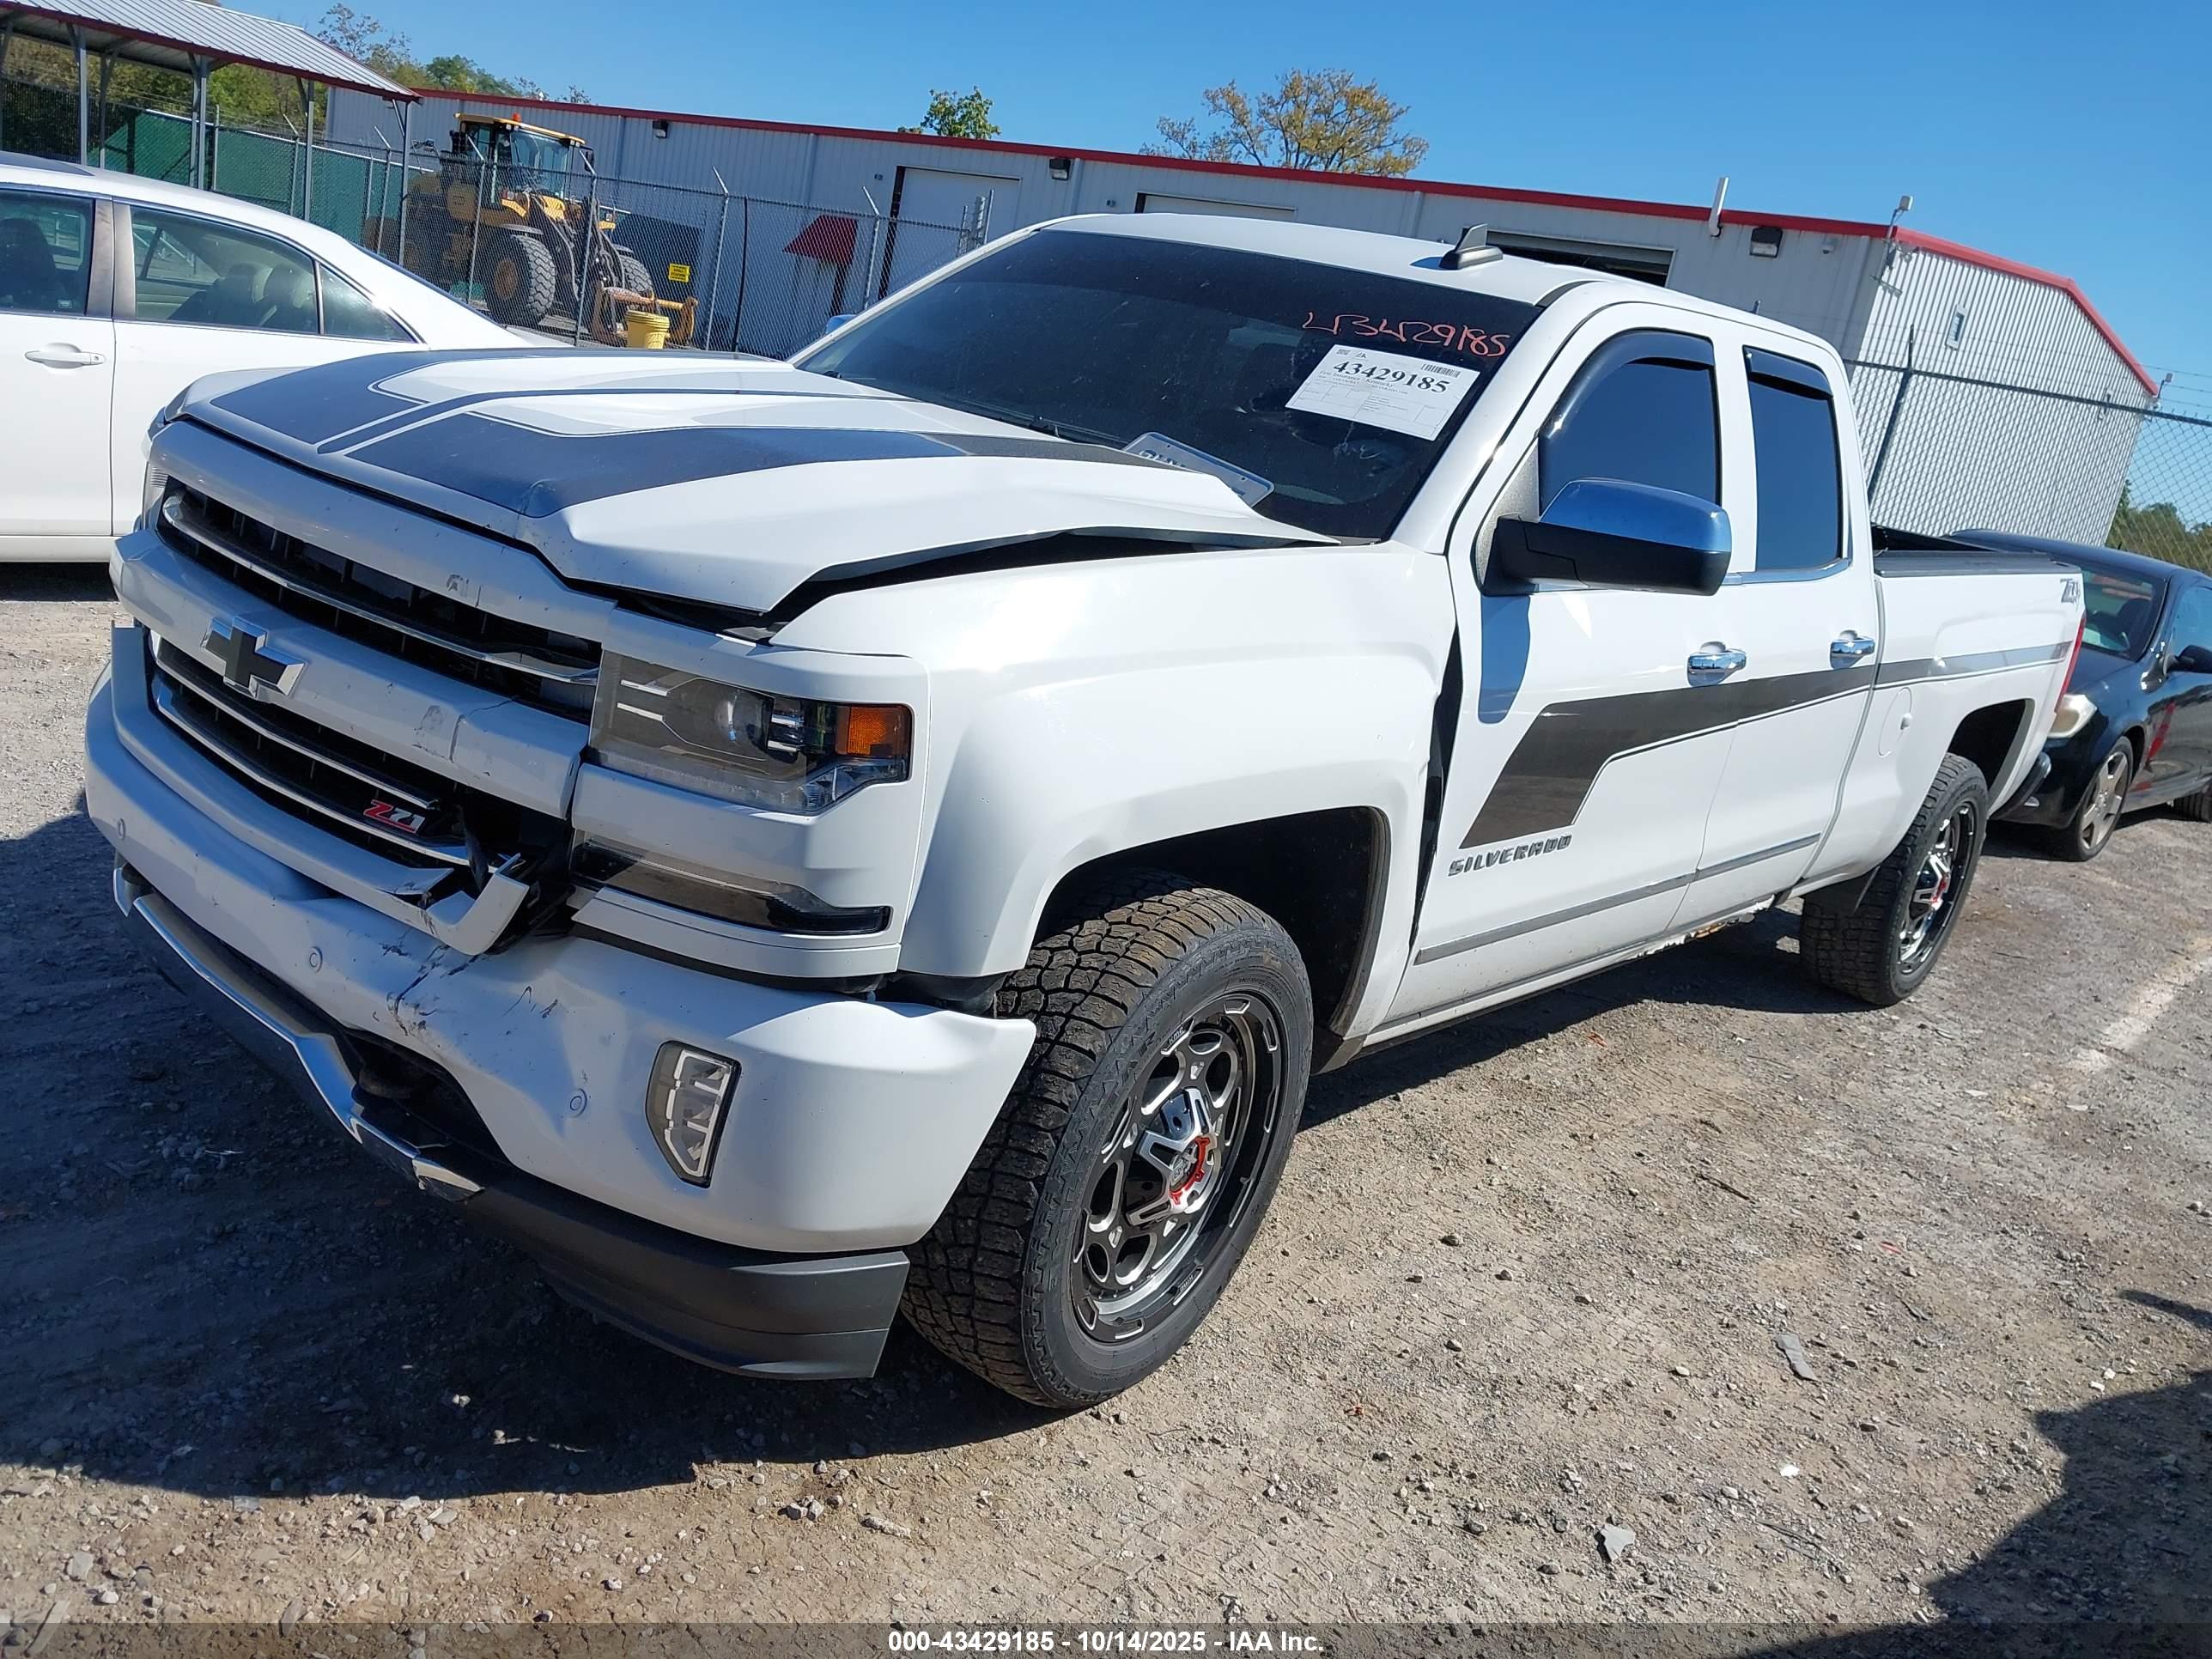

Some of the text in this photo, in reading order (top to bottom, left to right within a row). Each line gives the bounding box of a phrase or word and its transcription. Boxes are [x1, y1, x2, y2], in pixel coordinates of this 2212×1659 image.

[1302, 312, 1511, 357] 43429185
[1333, 361, 1450, 393] 43429185
[363, 799, 426, 834] Z71
[1448, 835, 1572, 877] SILVERADO
